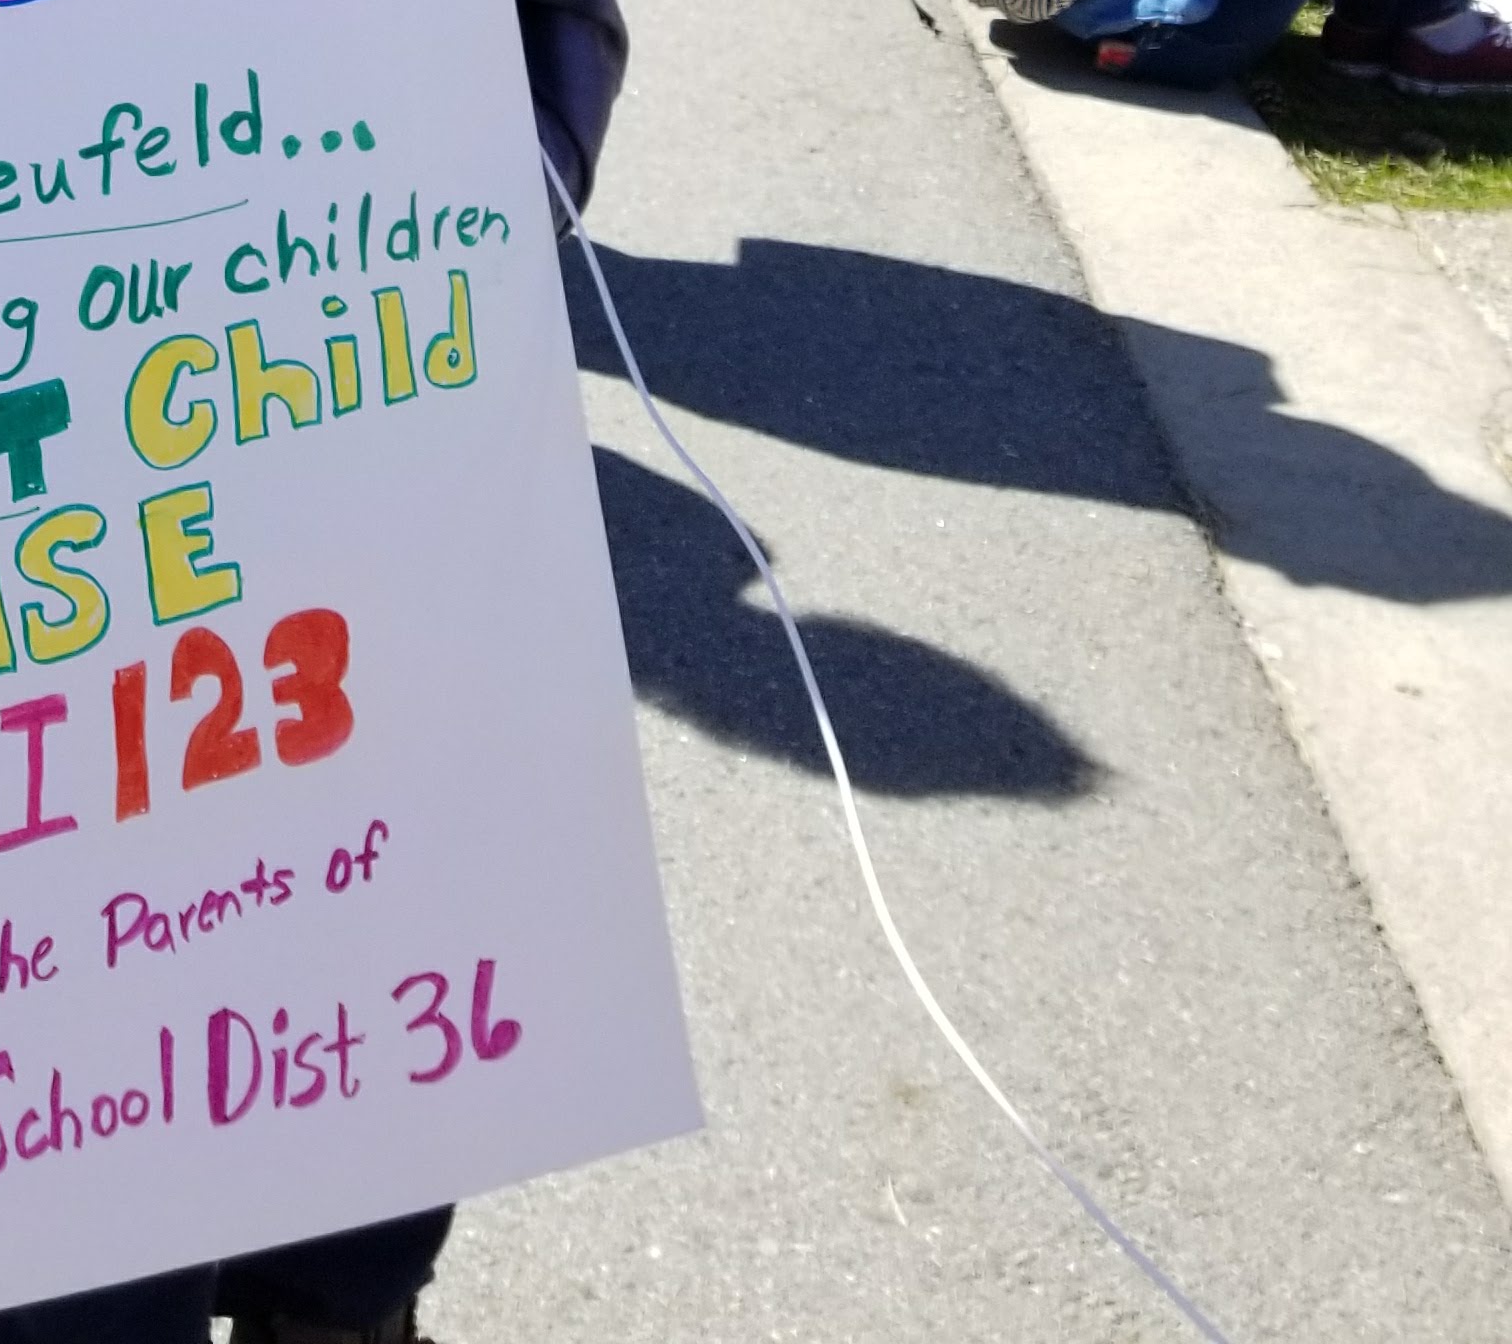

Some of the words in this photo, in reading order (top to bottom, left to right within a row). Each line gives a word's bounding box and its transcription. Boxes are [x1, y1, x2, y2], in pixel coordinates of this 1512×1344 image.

[87, 255, 194, 331] our
[224, 192, 510, 294] children
[124, 269, 478, 471] Child
[101, 857, 294, 968] Parents
[326, 819, 390, 892] of
[207, 1002, 361, 1124] Dist
[392, 958, 522, 1083] 36
